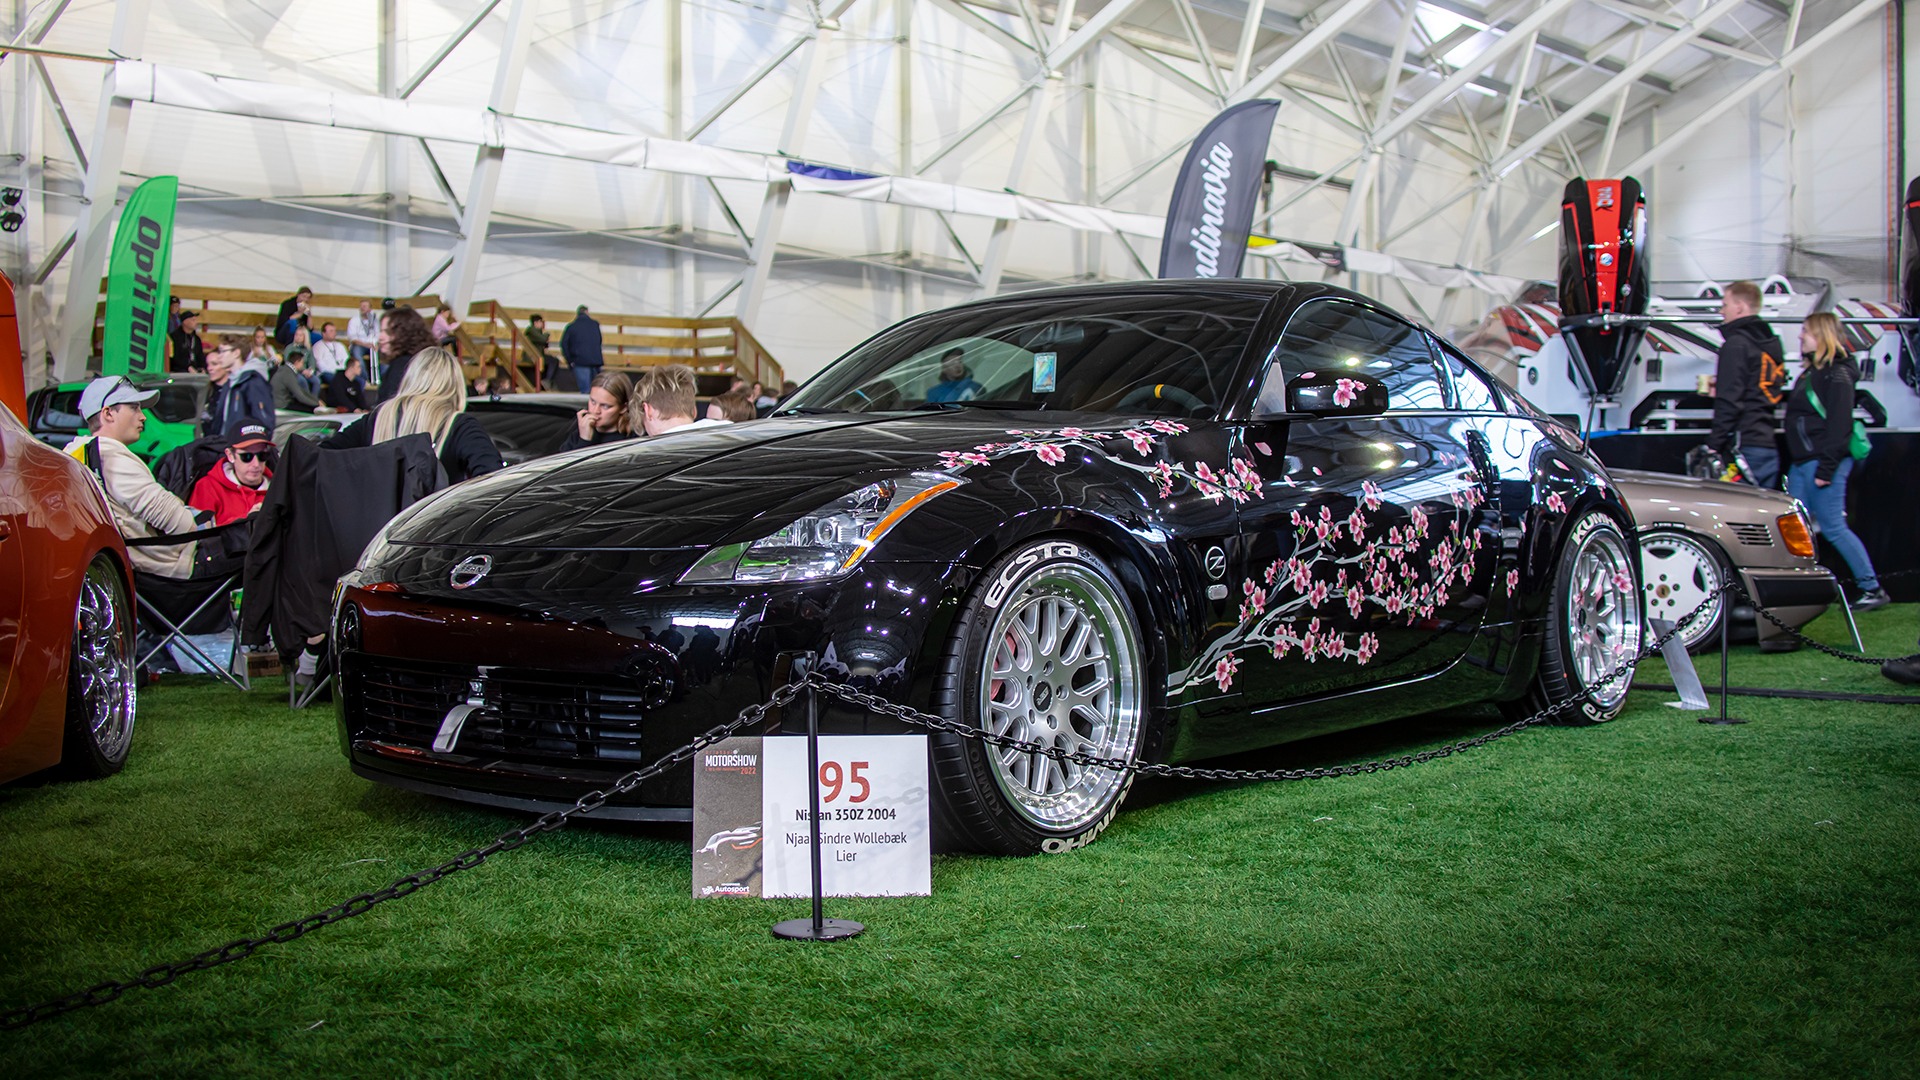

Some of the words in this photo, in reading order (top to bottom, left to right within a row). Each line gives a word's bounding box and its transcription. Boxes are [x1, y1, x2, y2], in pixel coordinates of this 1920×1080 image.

[129, 216, 161, 374] OptiTun
[705, 755, 757, 767] MOTORSHOW
[740, 767, 757, 775] 2022
[819, 760, 871, 803] 95
[795, 809, 832, 821] Nisan
[835, 808, 864, 820] 350Z
[867, 808, 897, 820] 2004
[786, 833, 810, 847] Njaa
[818, 832, 851, 844] Sindre
[853, 831, 908, 844] Wollebæk
[836, 849, 857, 862] Lier
[714, 885, 750, 893] Autosport
